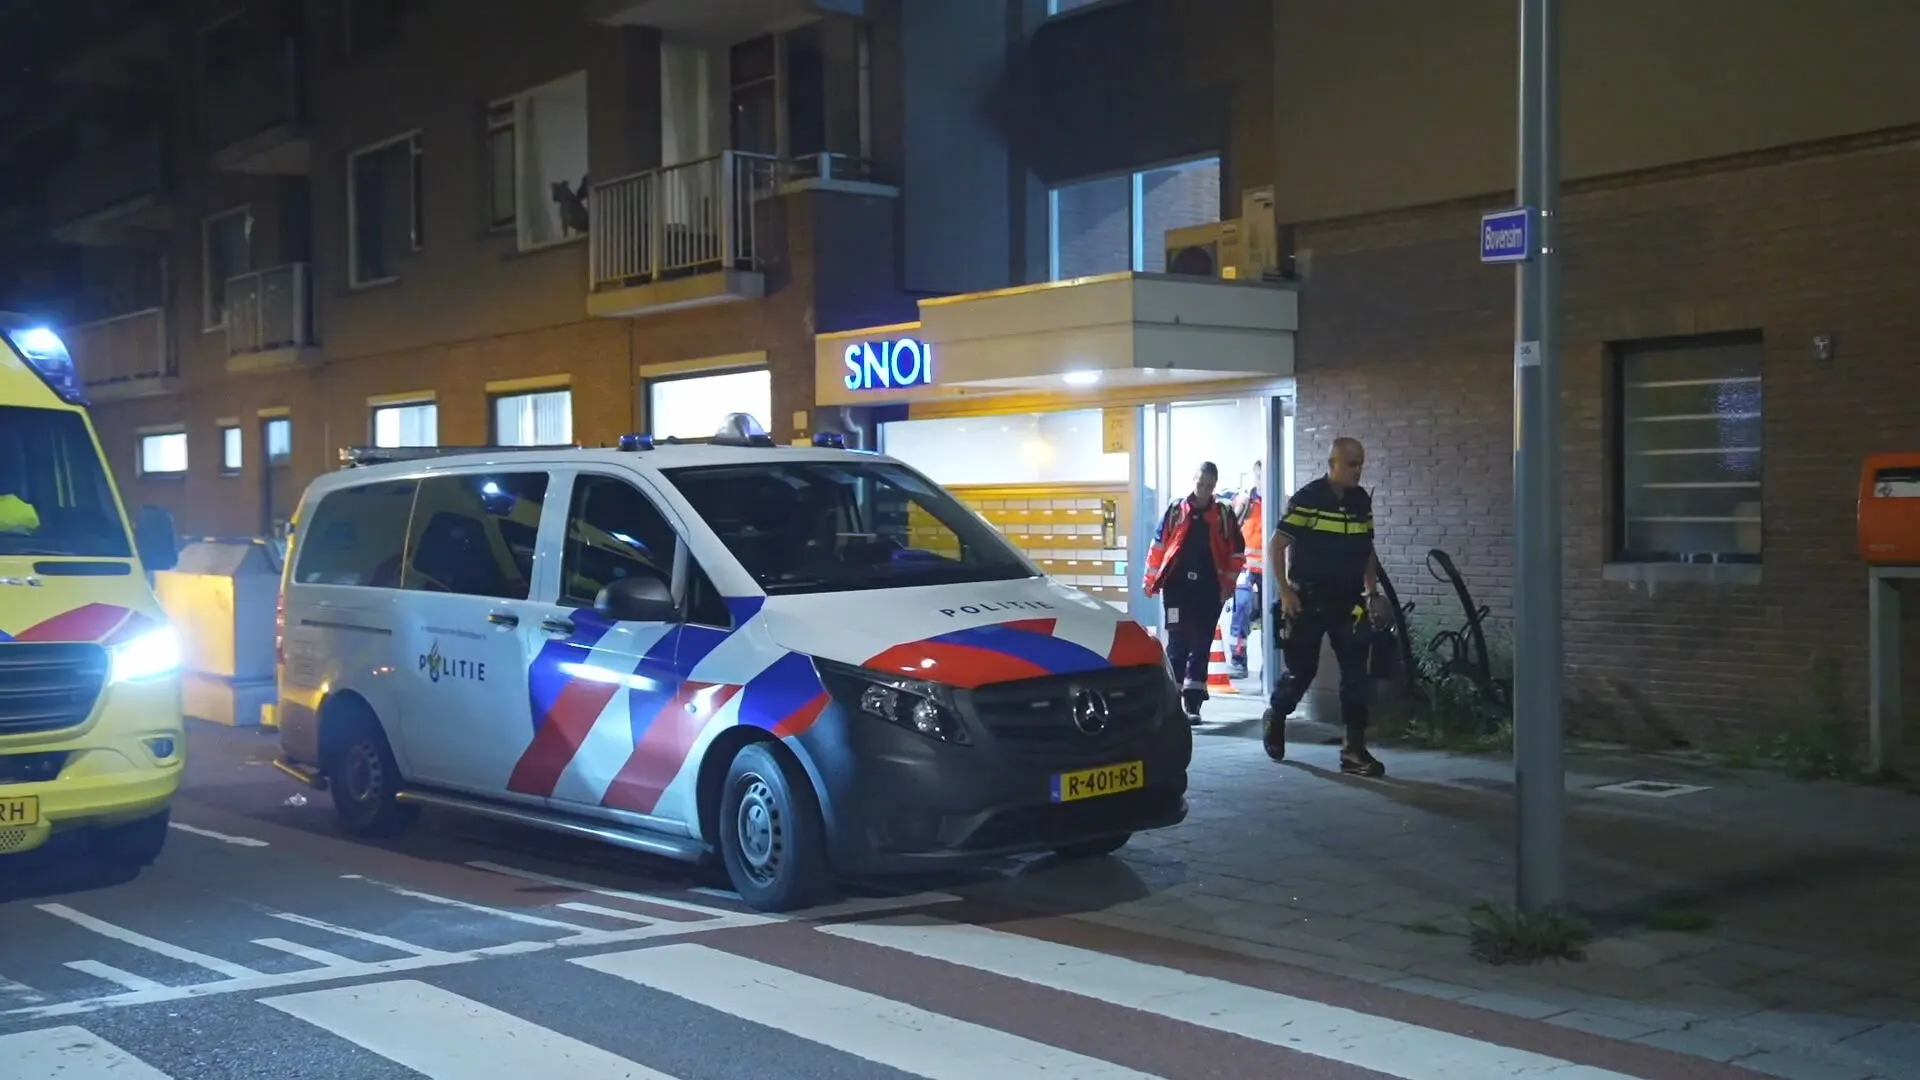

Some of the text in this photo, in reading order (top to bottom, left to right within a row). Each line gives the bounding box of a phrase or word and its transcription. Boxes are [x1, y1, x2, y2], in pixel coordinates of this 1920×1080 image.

[940, 601, 1055, 617] POLITIE
[419, 653, 485, 683] POLITIE
[1069, 766, 1138, 796] R-401-RS
